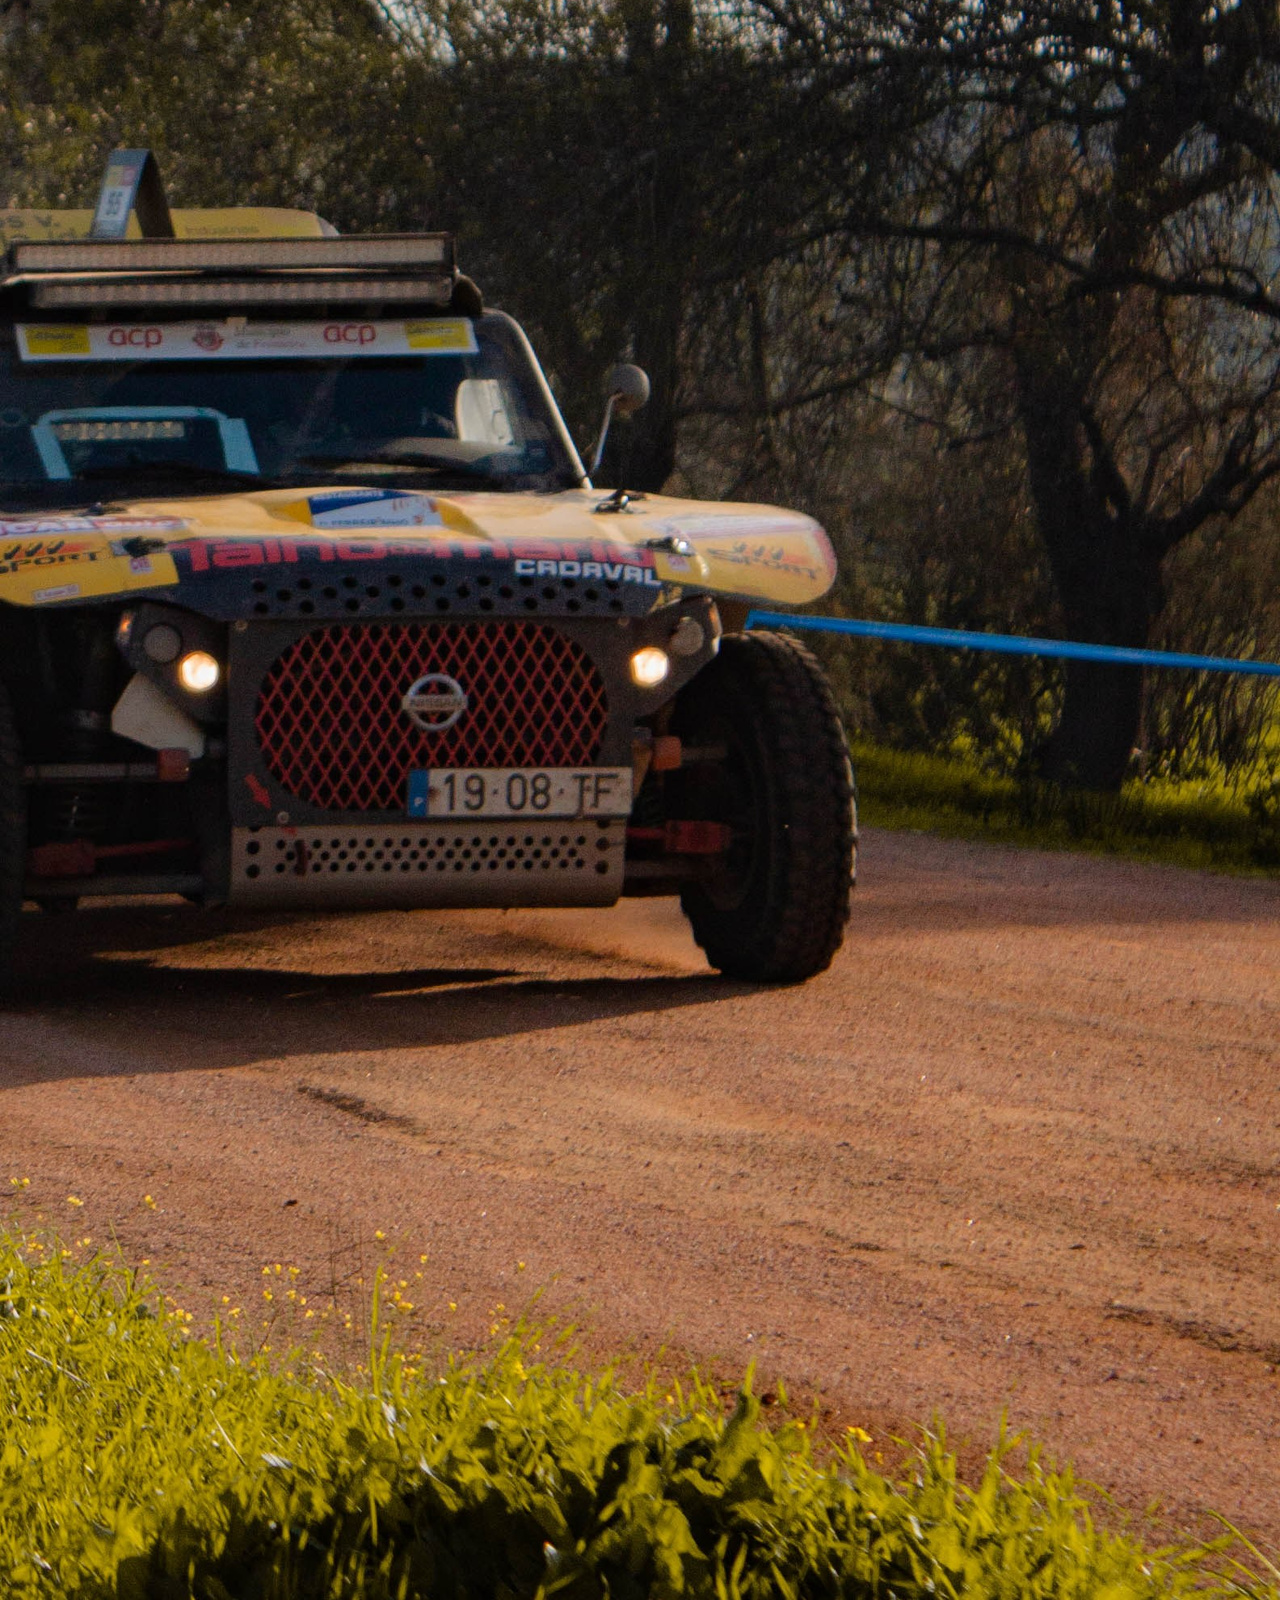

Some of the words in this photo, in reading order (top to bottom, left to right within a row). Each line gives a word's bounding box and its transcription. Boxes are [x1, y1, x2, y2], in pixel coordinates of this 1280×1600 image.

[108, 328, 162, 348] acp
[323, 324, 376, 345] acp
[515, 558, 663, 587] CADAVAL
